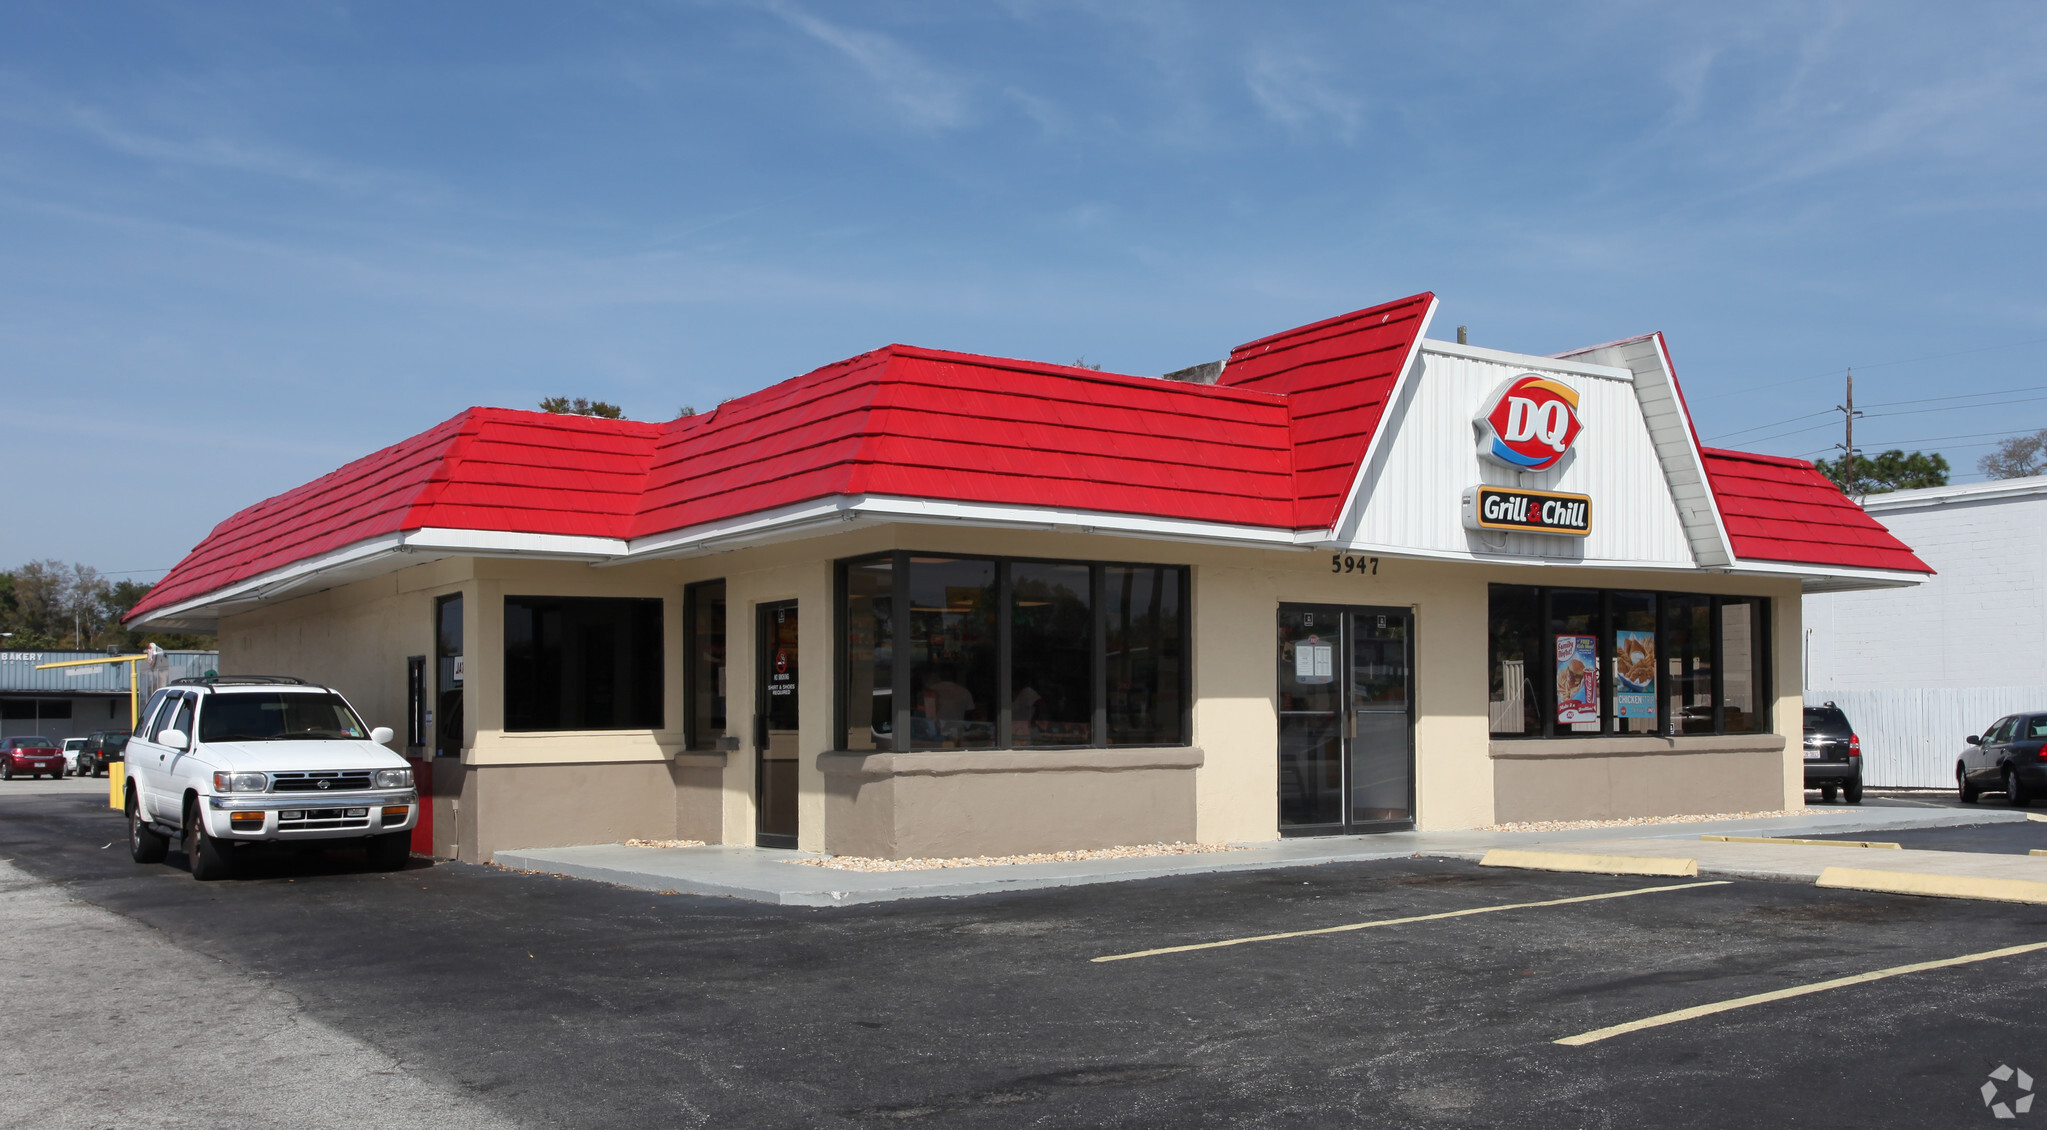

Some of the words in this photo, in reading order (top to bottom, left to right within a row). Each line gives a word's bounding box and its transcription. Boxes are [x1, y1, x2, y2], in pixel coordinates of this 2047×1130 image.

[1504, 396, 1569, 453] DQ
[1484, 495, 1528, 522] Grill
[1542, 500, 1585, 527] Chill
[1331, 554, 1379, 576] 5947
[1, 652, 43, 661] BAKERY
